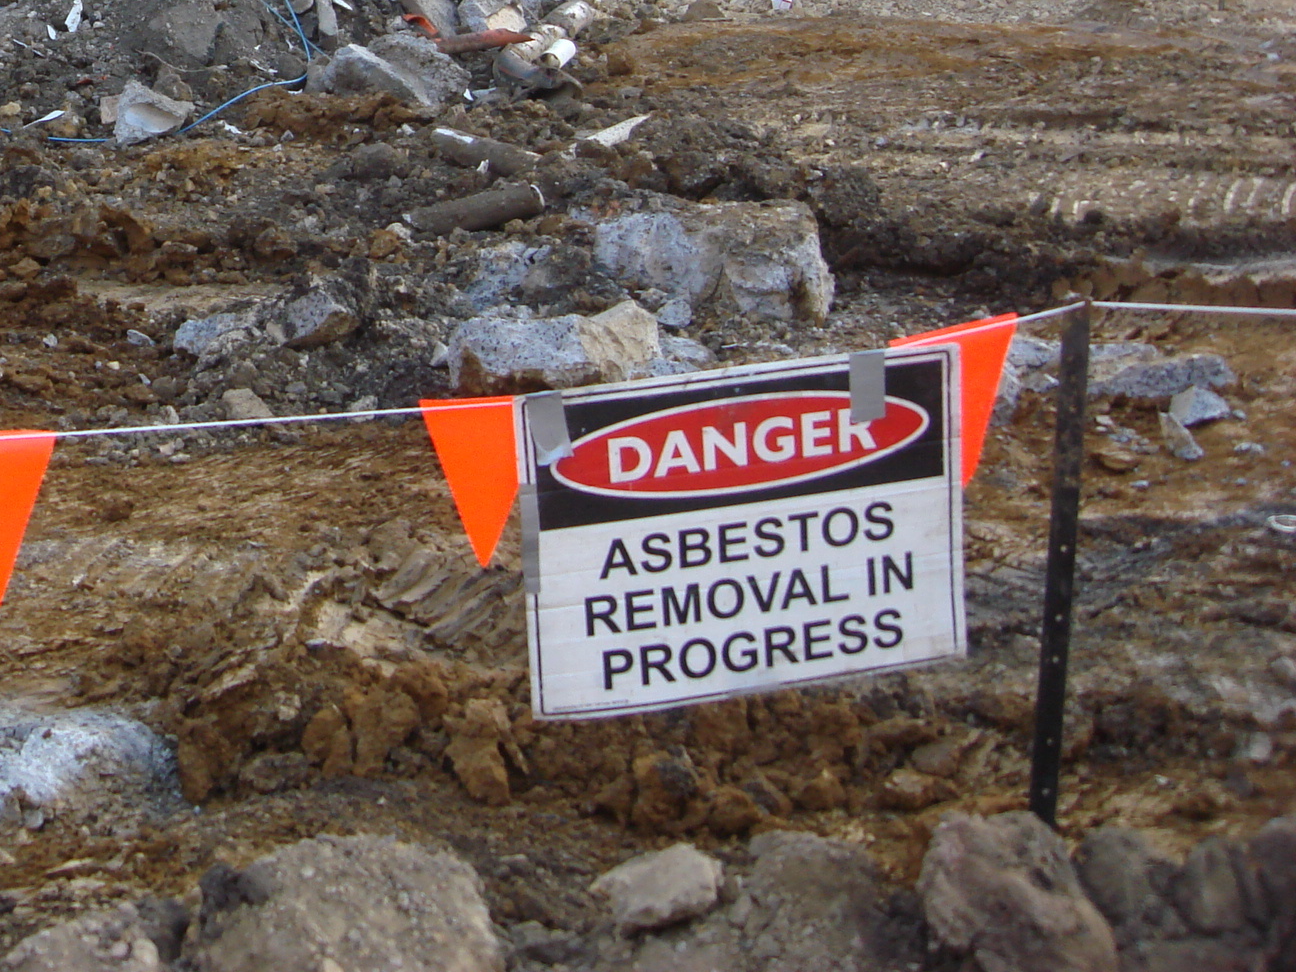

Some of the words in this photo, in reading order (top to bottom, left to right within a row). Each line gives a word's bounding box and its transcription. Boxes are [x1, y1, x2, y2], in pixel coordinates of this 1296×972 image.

[607, 408, 877, 484] DANGER
[599, 501, 895, 580] ASBESTOS
[584, 564, 850, 637] REMOVAL
[867, 551, 914, 597] IN
[602, 608, 904, 690] PROGRESS
